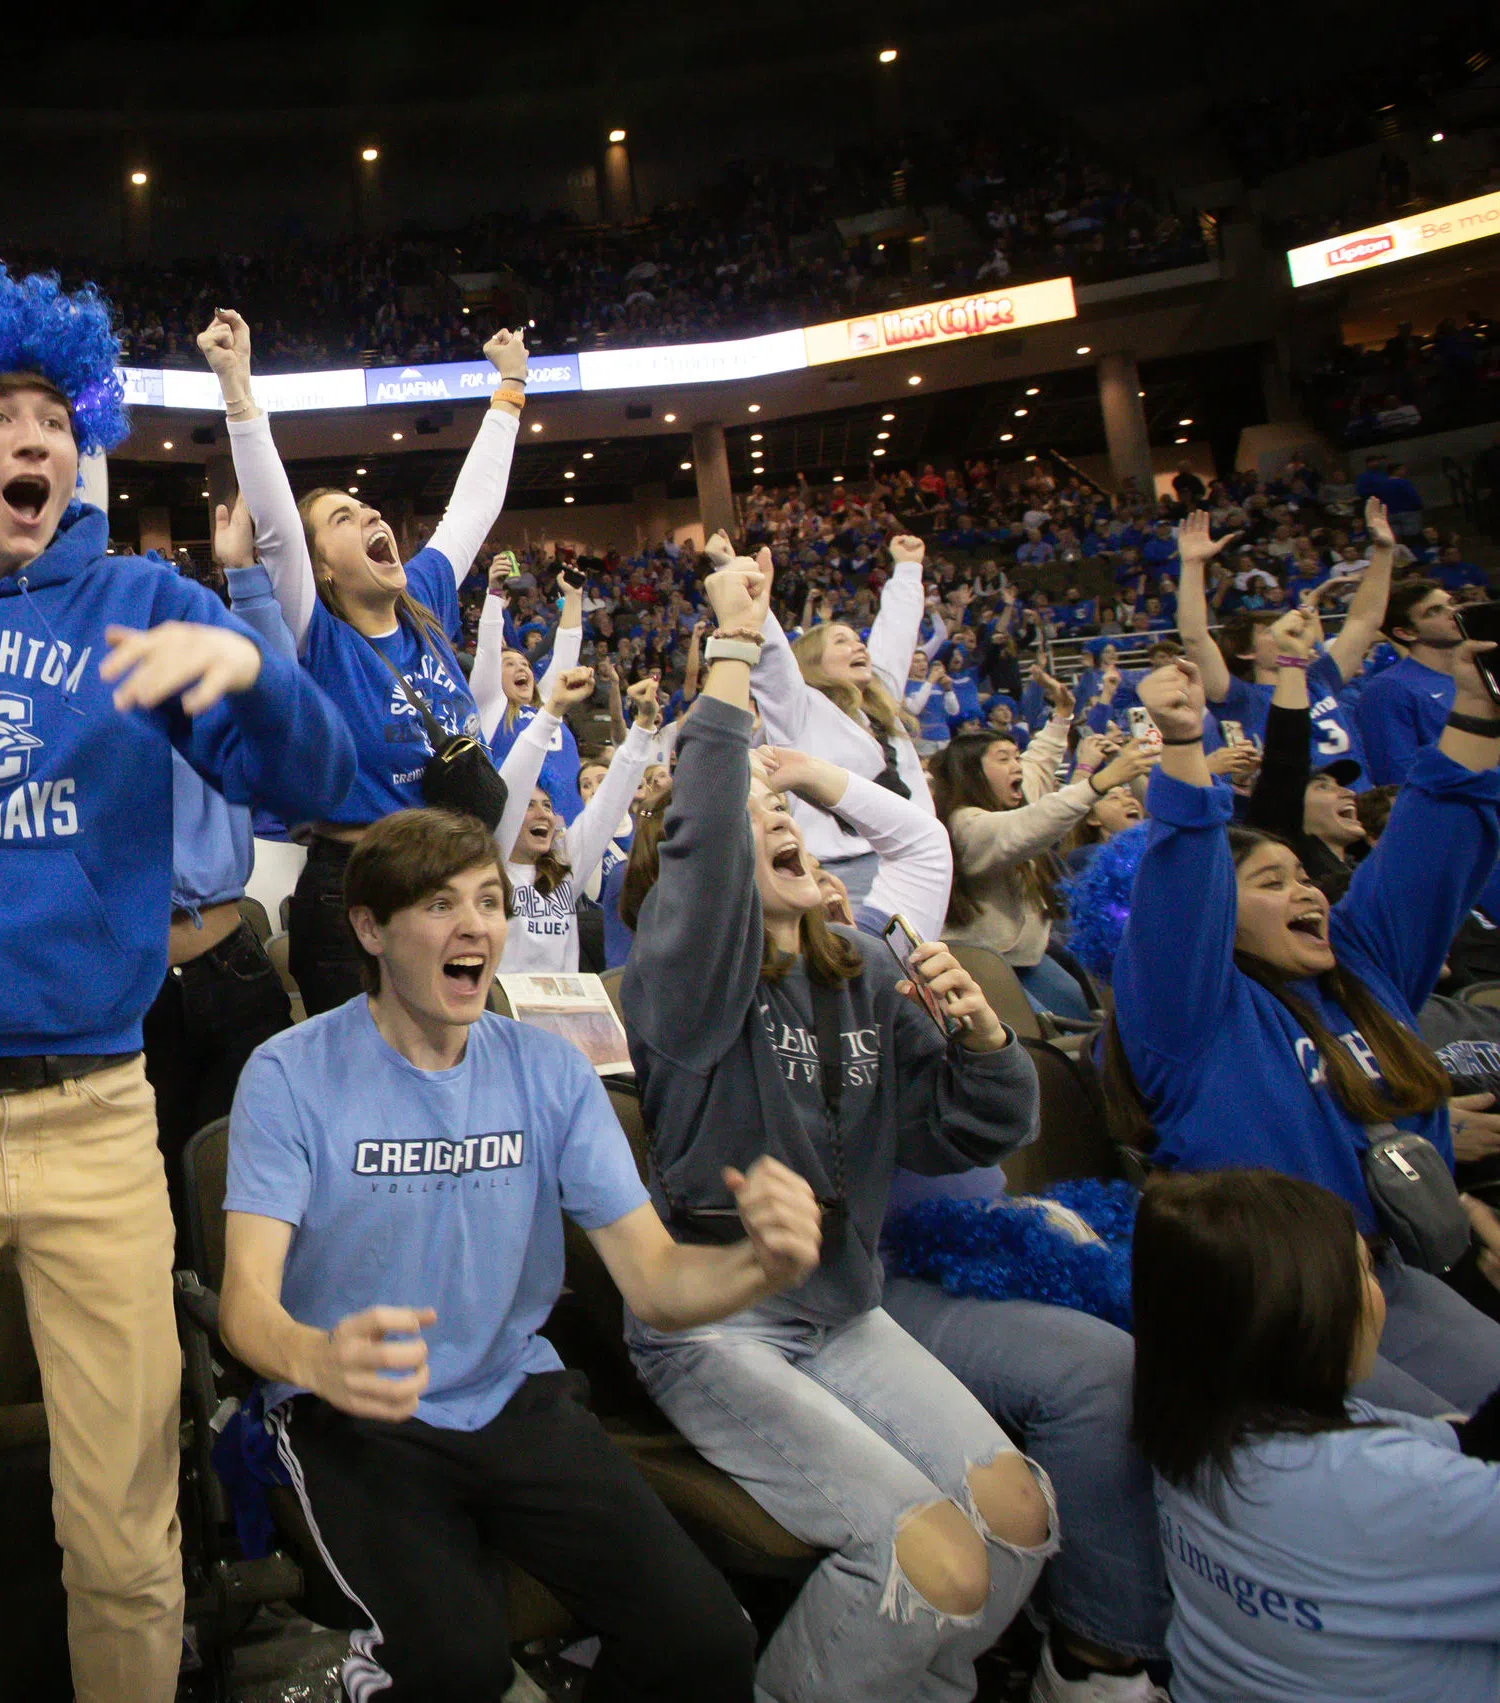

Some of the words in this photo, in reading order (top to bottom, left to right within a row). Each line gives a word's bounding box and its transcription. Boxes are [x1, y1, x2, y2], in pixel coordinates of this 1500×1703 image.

[1421, 222, 1453, 240] Be
[1329, 237, 1391, 264] Lipton
[938, 297, 1014, 335] Coffee
[376, 378, 451, 402] AQUAFINA
[460, 371, 484, 388] FOR
[1316, 718, 1351, 755] 3
[353, 1131, 525, 1177] CREIGHTON
[371, 1176, 512, 1194] VOLLEALL
[1177, 1523, 1324, 1622] images
